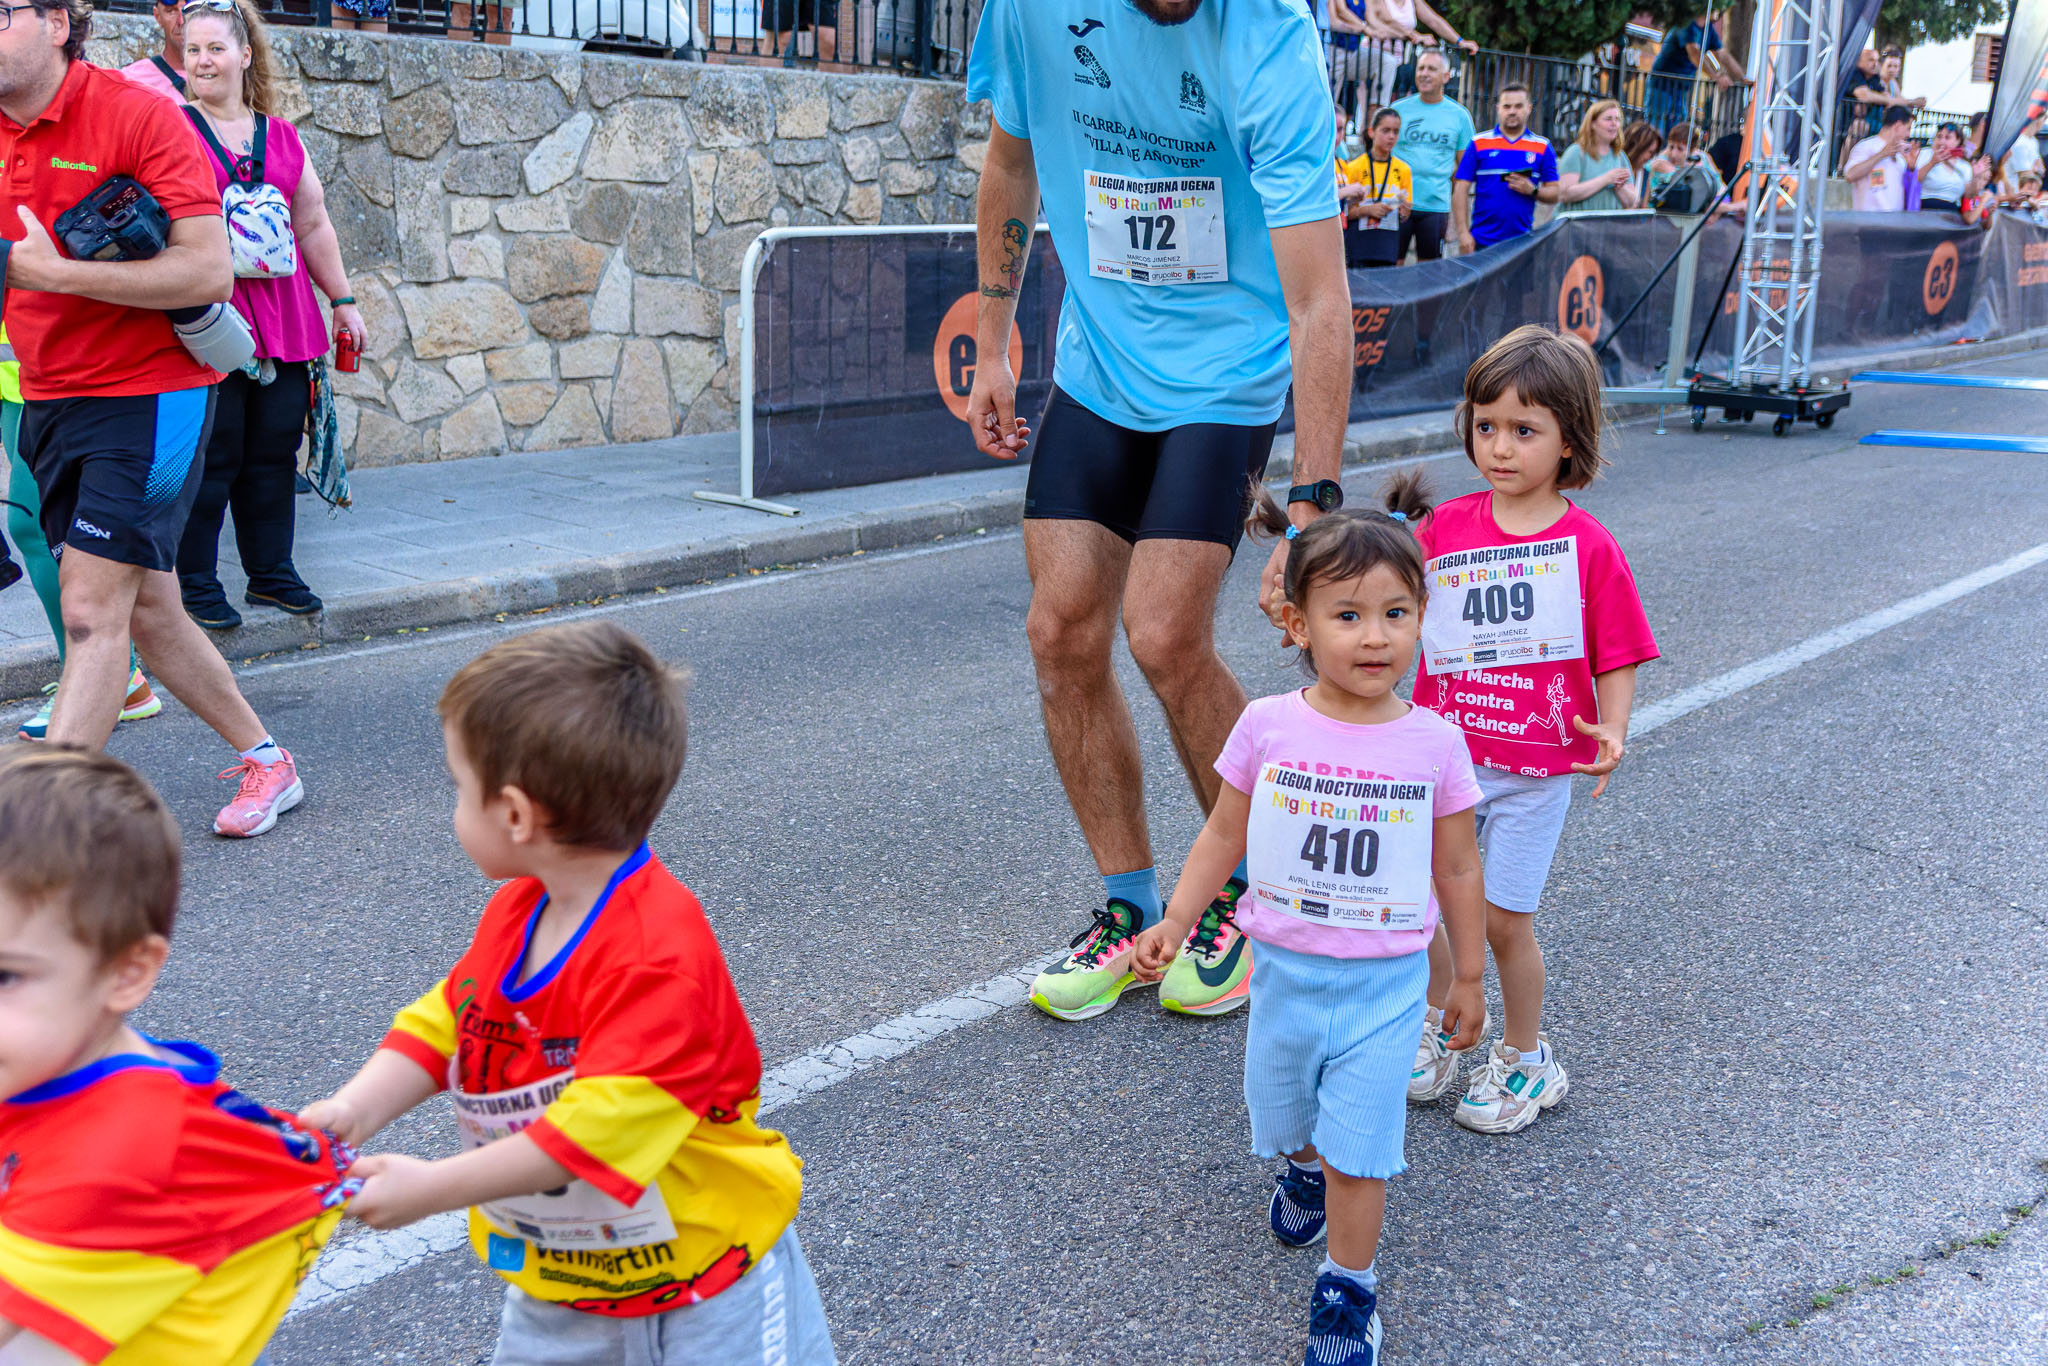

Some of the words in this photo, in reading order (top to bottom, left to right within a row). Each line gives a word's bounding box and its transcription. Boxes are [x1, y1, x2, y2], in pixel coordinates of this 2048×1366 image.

[1072, 110, 1081, 123] II
[1083, 114, 1137, 139] CARRERA
[1140, 129, 1216, 152] NOCTURNA
[1089, 174, 1098, 186] XI
[1098, 177, 1125, 191] LEGUA
[1126, 181, 1178, 194] NOCTURNA
[1181, 180, 1215, 191] UGENA
[1124, 214, 1176, 250] 172
[1126, 254, 1151, 262] MARCOS
[1929, 258, 1954, 298] e3
[1567, 275, 1596, 329] e3
[1429, 560, 1438, 573] XI
[1438, 552, 1468, 571] LEGUA
[1470, 545, 1530, 565] NOCTURNA
[1533, 540, 1569, 557] UGENA
[1462, 582, 1534, 626] 409
[1473, 632, 1496, 640] NAYAH
[1498, 628, 1528, 637] JIMÉNEZ
[1466, 669, 1534, 690] Marcha
[1454, 691, 1515, 711] contra
[1444, 709, 1461, 725] el
[1464, 712, 1528, 736] Cáncer
[1264, 766, 1277, 783] XI
[1276, 769, 1311, 792] LEGUA
[1314, 778, 1387, 800] NOCTURNA
[1390, 784, 1426, 801] UGENA
[1300, 823, 1380, 878] 410
[1288, 875, 1310, 887] AVRIL
[1311, 880, 1337, 891] LENIS
[1339, 883, 1389, 895] GUTIÉRREZ
[1304, 888, 1330, 897] EVENTOS
